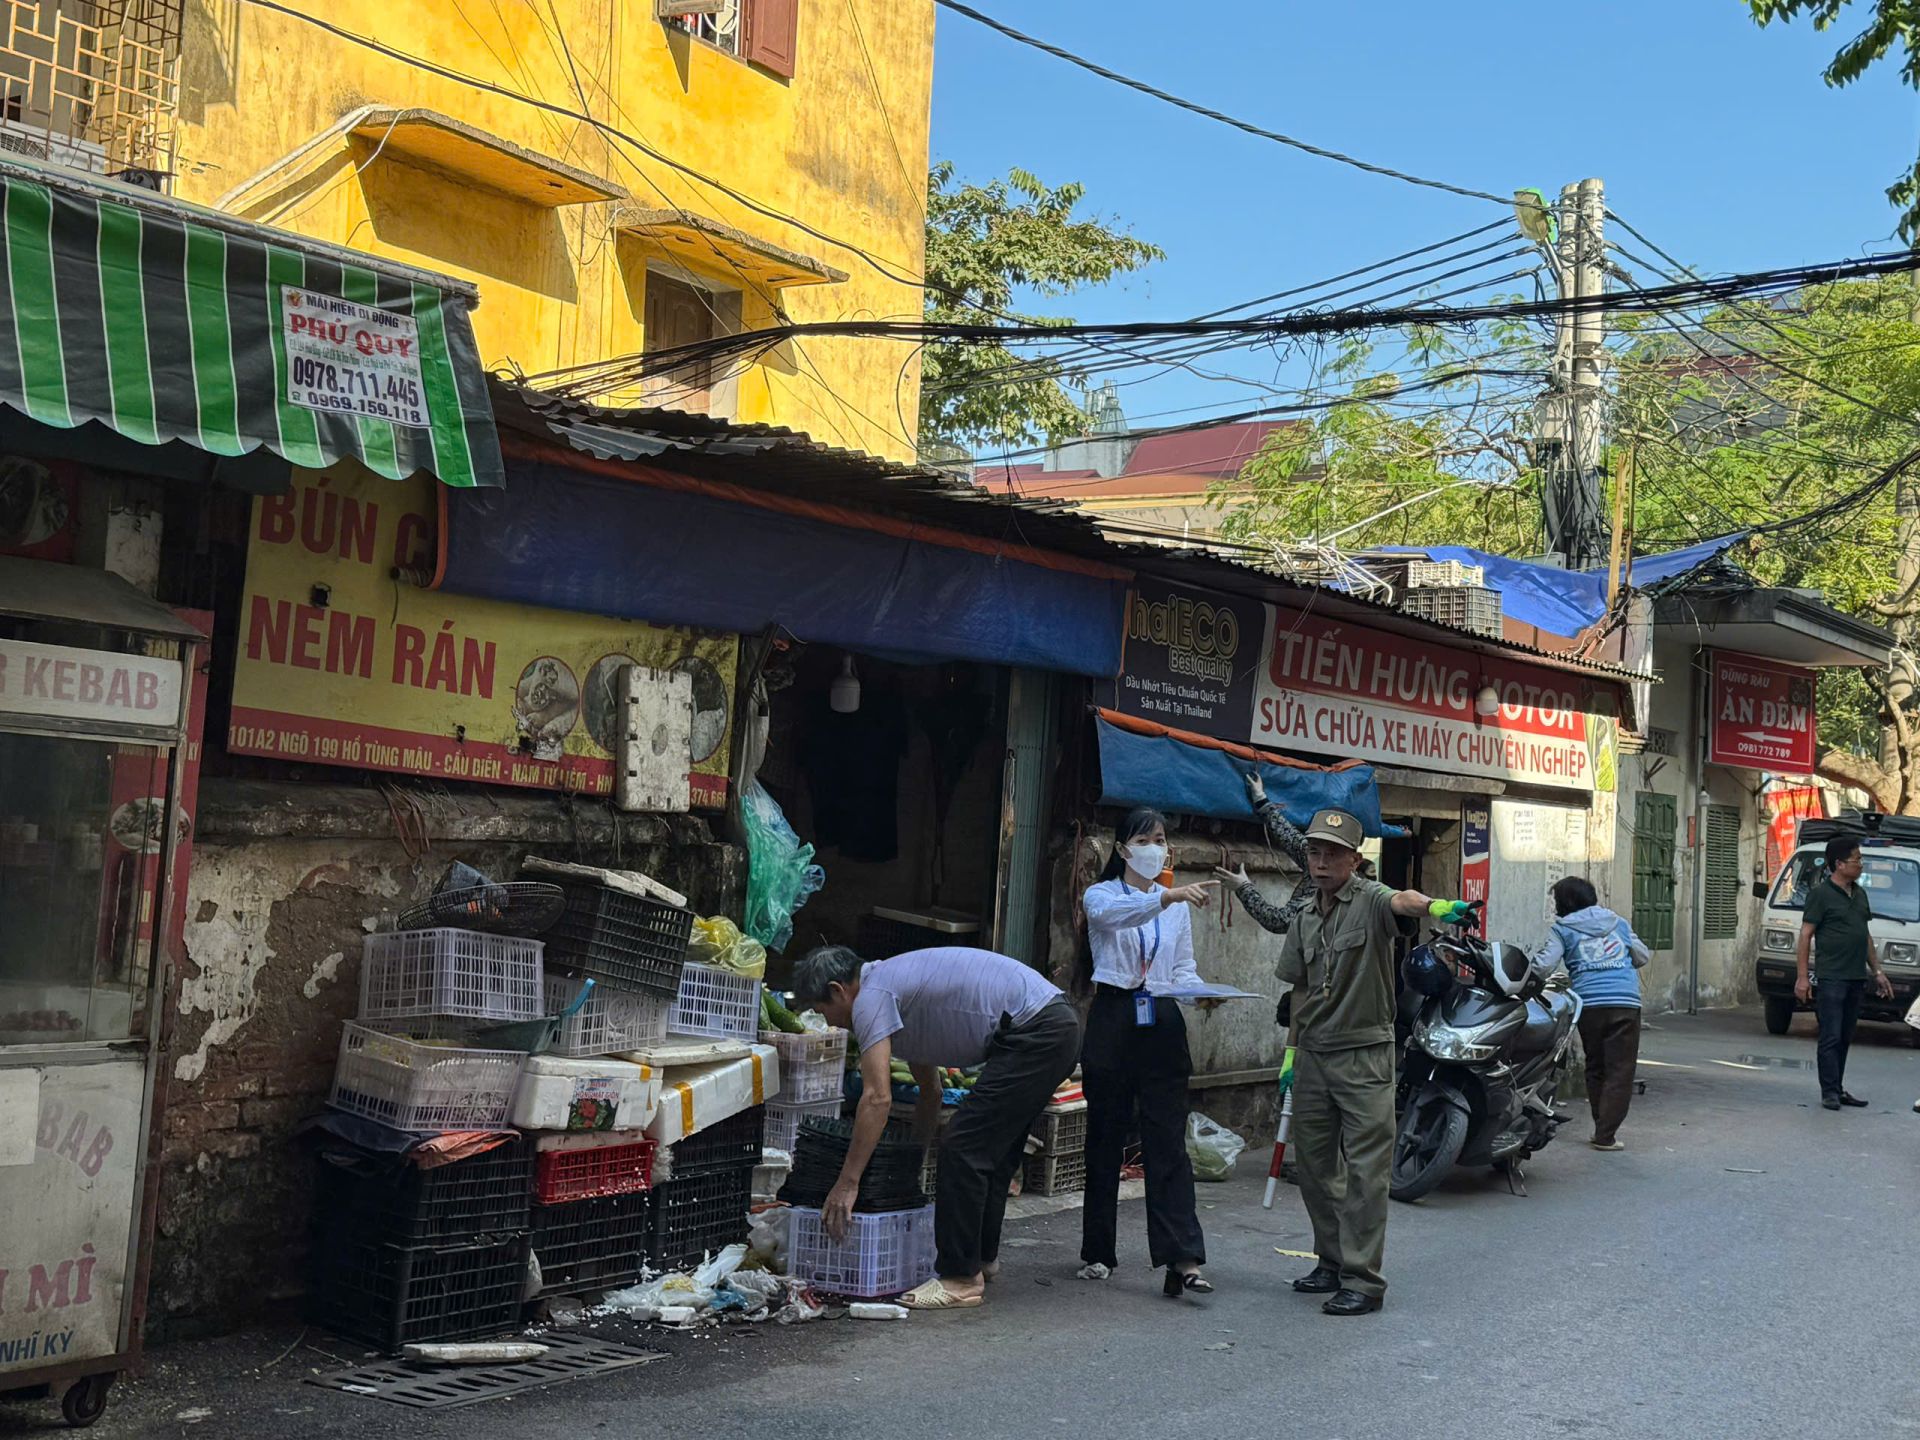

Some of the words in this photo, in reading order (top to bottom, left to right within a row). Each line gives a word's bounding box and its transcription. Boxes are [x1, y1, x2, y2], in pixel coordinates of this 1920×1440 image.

[289, 312, 348, 345] PHÚ
[372, 311, 399, 328] ĐỘNG
[293, 355, 419, 408] 0978.711.445
[307, 391, 421, 423] 0969.159.118
[259, 476, 379, 565] BÚN
[247, 594, 376, 680] NEM
[392, 619, 497, 700] RÁN
[1169, 646, 1197, 675] Best
[1196, 655, 1233, 687] quality
[23, 655, 159, 711] KEBAB
[1125, 675, 1140, 689] Dầu
[1141, 678, 1160, 693] Nhớt
[1161, 682, 1176, 696] Tiêu
[1200, 689, 1217, 703] Quốc
[1218, 692, 1226, 704] Tế
[1279, 628, 1362, 692] TIẾN
[1371, 650, 1468, 711] HƯNG
[1141, 696, 1154, 710] Sản
[1155, 699, 1171, 713] Xuất
[1172, 702, 1182, 716] Tại
[1184, 703, 1212, 719] Thailand
[1720, 686, 1754, 724] ĂN
[1761, 695, 1807, 733] ĐÊM
[1260, 688, 1308, 738] SỬA
[1315, 705, 1377, 749] CHỮA
[1382, 718, 1406, 753] XE
[1412, 721, 1452, 760] MÁY
[1456, 731, 1526, 771] CHUYÊN
[1530, 744, 1586, 783] NGHIỆP
[1738, 742, 1758, 753] 0981
[1759, 745, 1773, 754] 772
[1775, 747, 1791, 758] 789
[229, 725, 276, 751] 101A2
[278, 729, 309, 755] NGÕ
[314, 736, 339, 759] 199
[342, 734, 361, 762] HỒ
[364, 740, 399, 768] TÙNG
[402, 745, 432, 774] MẬU
[443, 750, 469, 776] CẦU
[472, 752, 501, 779] DIỄN
[511, 763, 540, 785] NAM
[596, 773, 613, 793] HN
[1466, 879, 1486, 900] THAY
[24, 1242, 97, 1314] MÌ
[0, 1329, 41, 1362] NHĨ
[43, 1325, 74, 1357] KỲ
